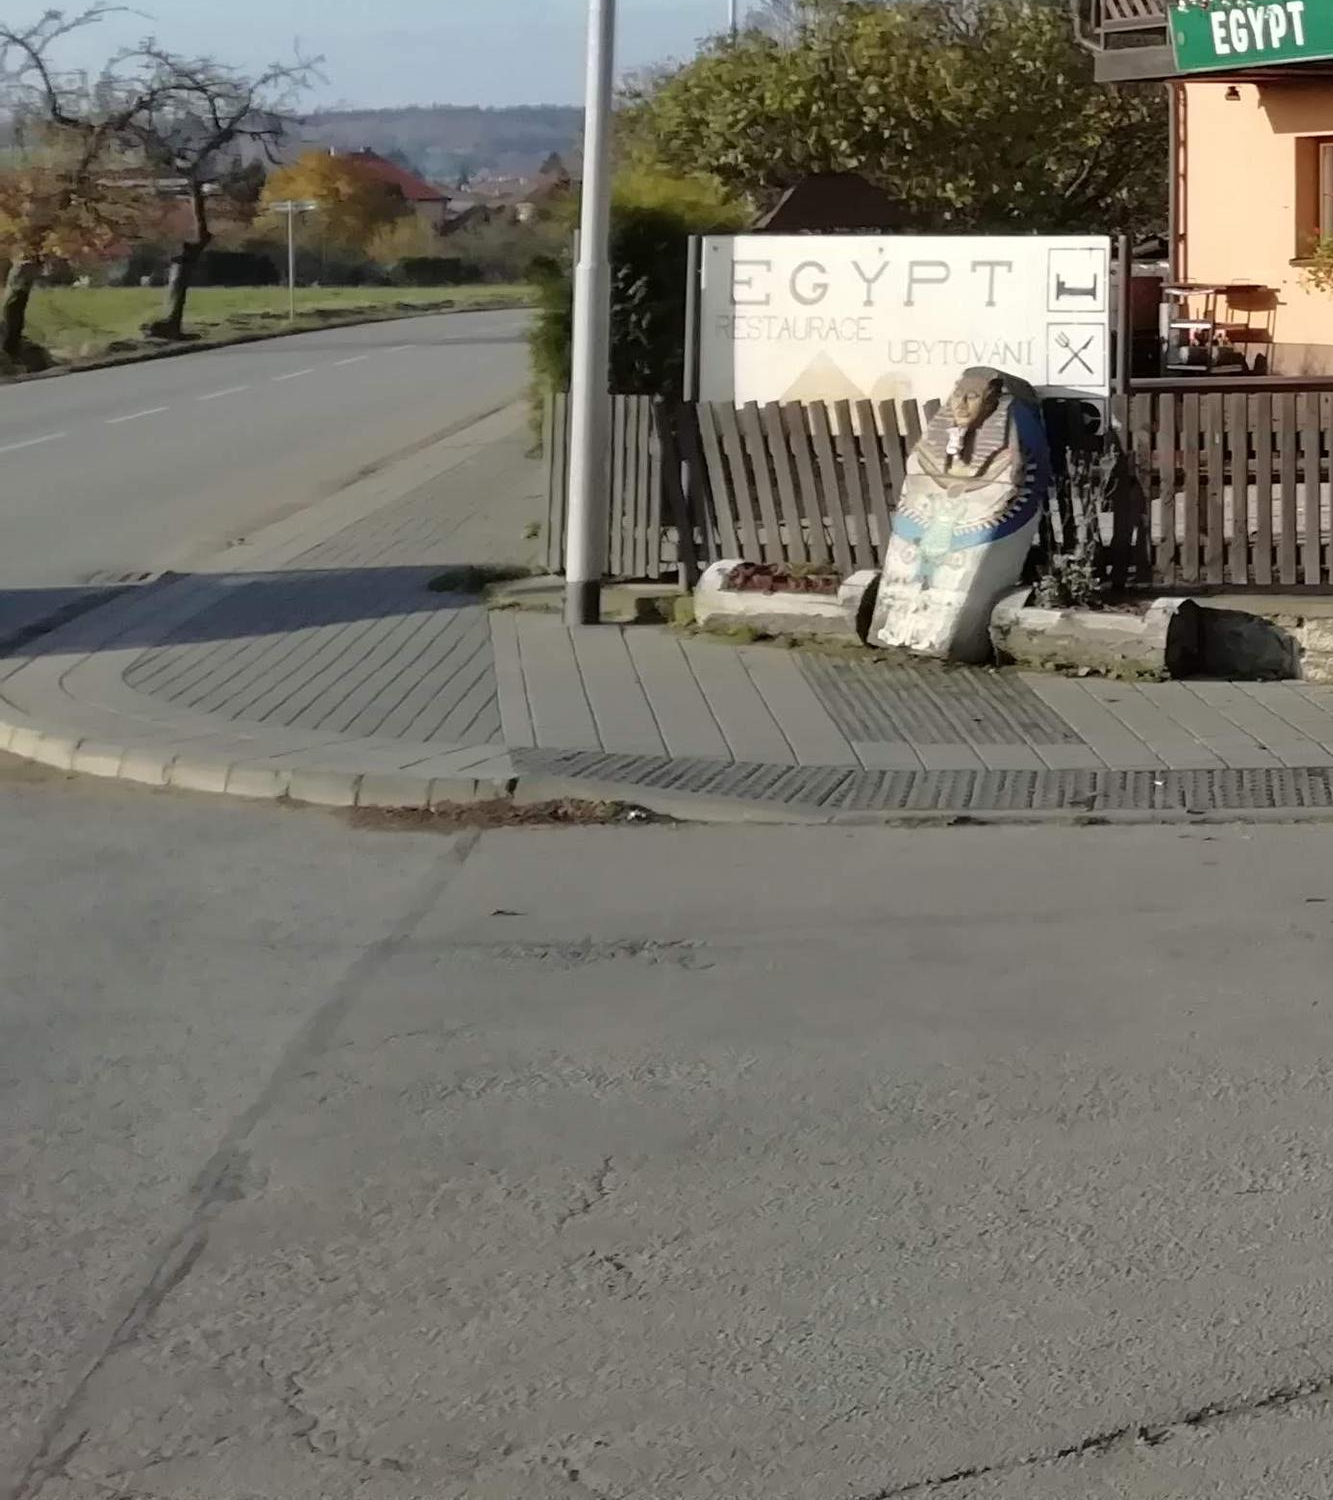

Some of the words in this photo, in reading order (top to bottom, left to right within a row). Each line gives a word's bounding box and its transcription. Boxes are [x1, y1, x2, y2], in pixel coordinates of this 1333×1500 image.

[1210, 1, 1304, 55] EGYPT
[731, 260, 1014, 307] EGYPT
[715, 316, 873, 341] RESTAURACE
[888, 337, 1036, 366] UBYTOVÁNÍ
